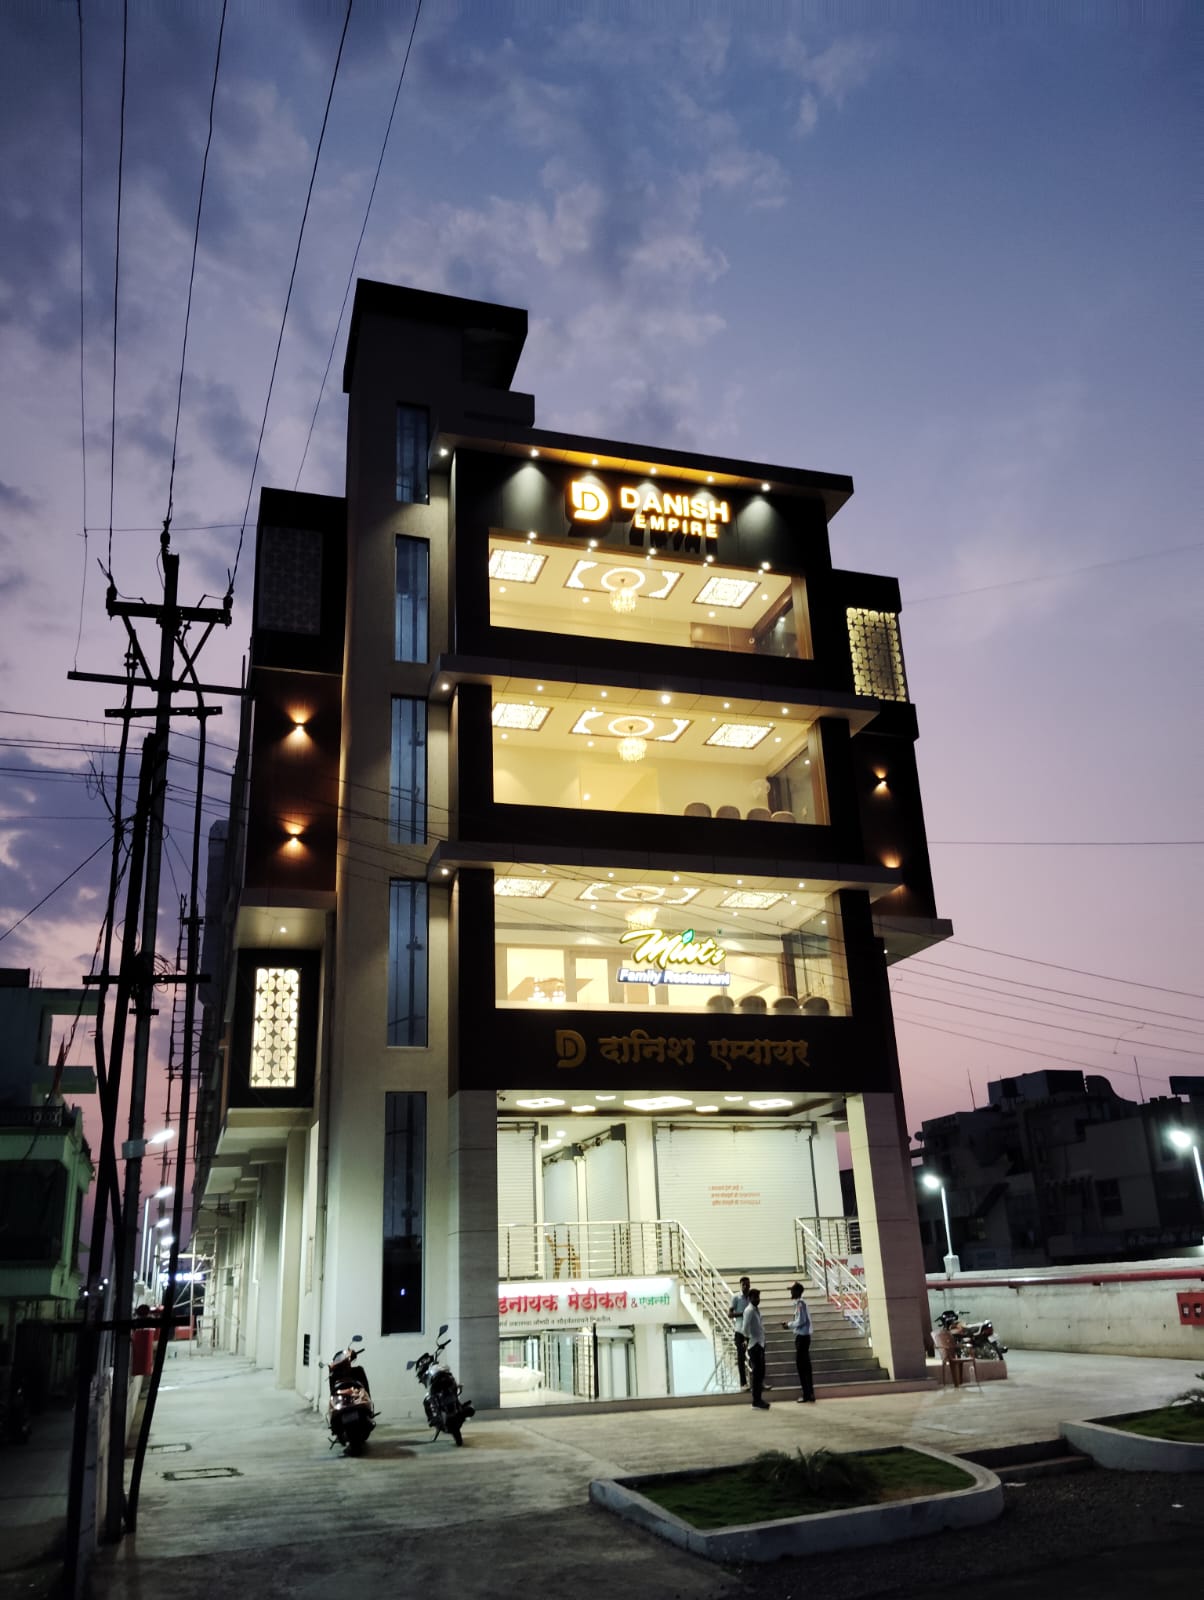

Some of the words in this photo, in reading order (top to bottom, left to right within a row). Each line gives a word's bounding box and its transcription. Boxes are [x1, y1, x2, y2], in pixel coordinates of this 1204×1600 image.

[620, 487, 731, 523] DANISH
[634, 514, 719, 538] EMPIRE
[618, 968, 662, 986] Family
[662, 969, 730, 987] Restaurant
[598, 1029, 695, 1065] दानिश
[708, 1038, 810, 1071] एम्पायर
[567, 1287, 627, 1312] मेडीकल
[631, 1297, 638, 1309] &
